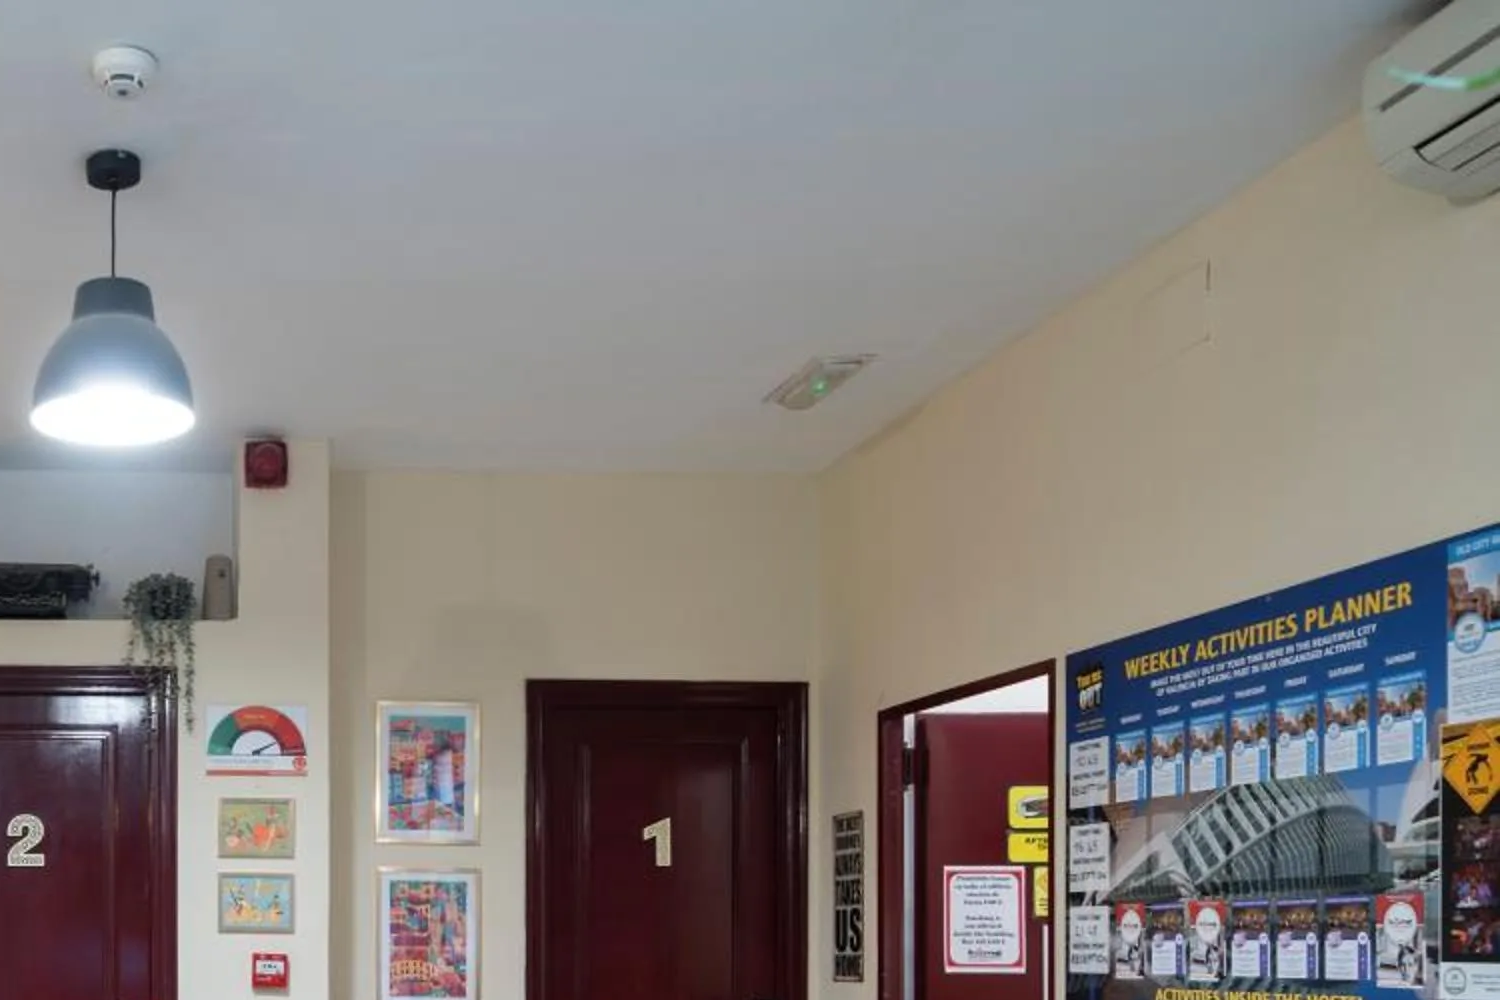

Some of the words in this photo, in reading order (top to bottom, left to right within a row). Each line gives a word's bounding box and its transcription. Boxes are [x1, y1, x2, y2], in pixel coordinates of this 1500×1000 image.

[1124, 643, 1191, 680] WEEKLY
[1194, 612, 1299, 662] ACTIVITIES
[1304, 580, 1412, 633] PLANNER
[6, 813, 46, 867] 2
[642, 816, 672, 867] 1
[835, 907, 862, 953] US
